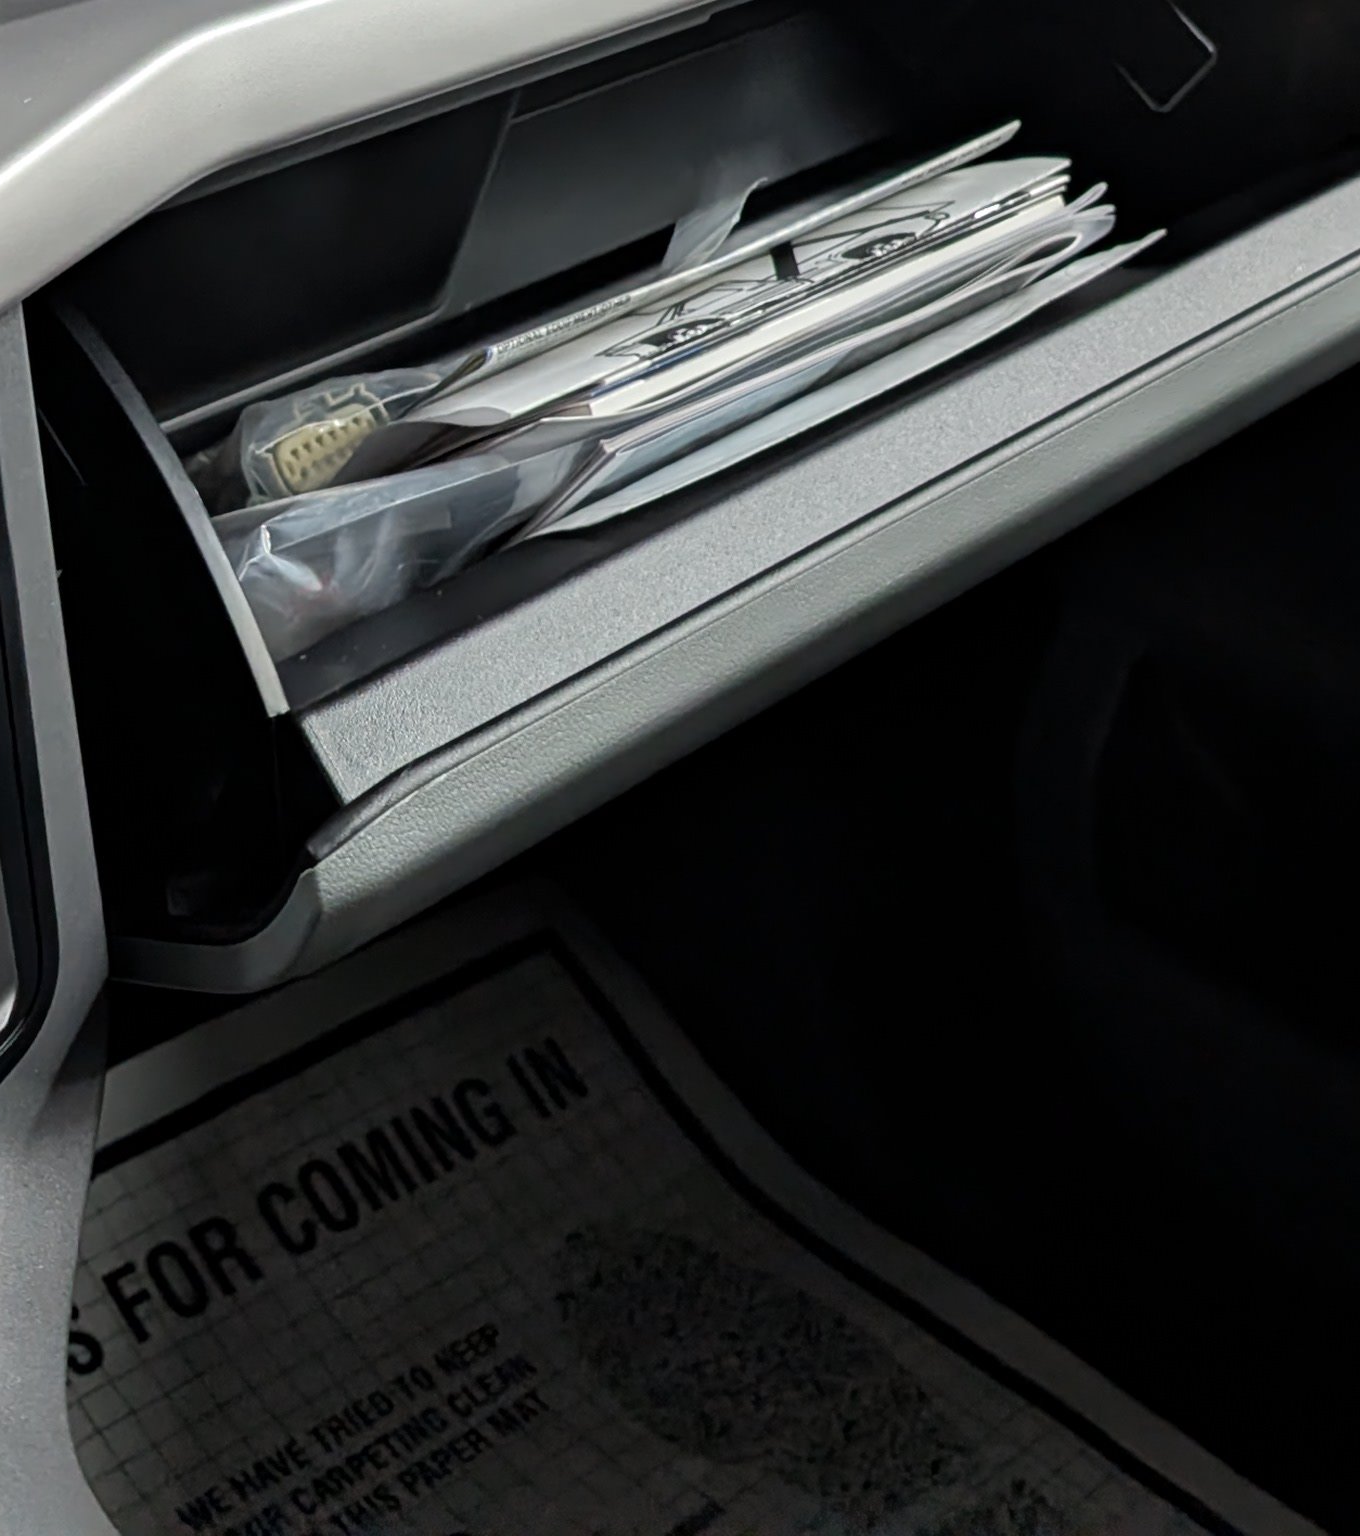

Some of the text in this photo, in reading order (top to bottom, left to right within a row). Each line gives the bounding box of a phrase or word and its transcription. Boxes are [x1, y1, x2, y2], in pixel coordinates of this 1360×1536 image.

[102, 1215, 264, 1344] FOR
[256, 1077, 517, 1256] COMING
[506, 1036, 589, 1119] IN
[176, 1485, 233, 1532] WE
[229, 1435, 311, 1502] HAVE
[308, 1390, 395, 1453] TRIED
[391, 1365, 436, 1401] TO
[289, 1406, 449, 1515] CARPETING
[447, 1354, 538, 1419] CLEAN
[329, 1387, 551, 1536] THIS PAPER MAT
